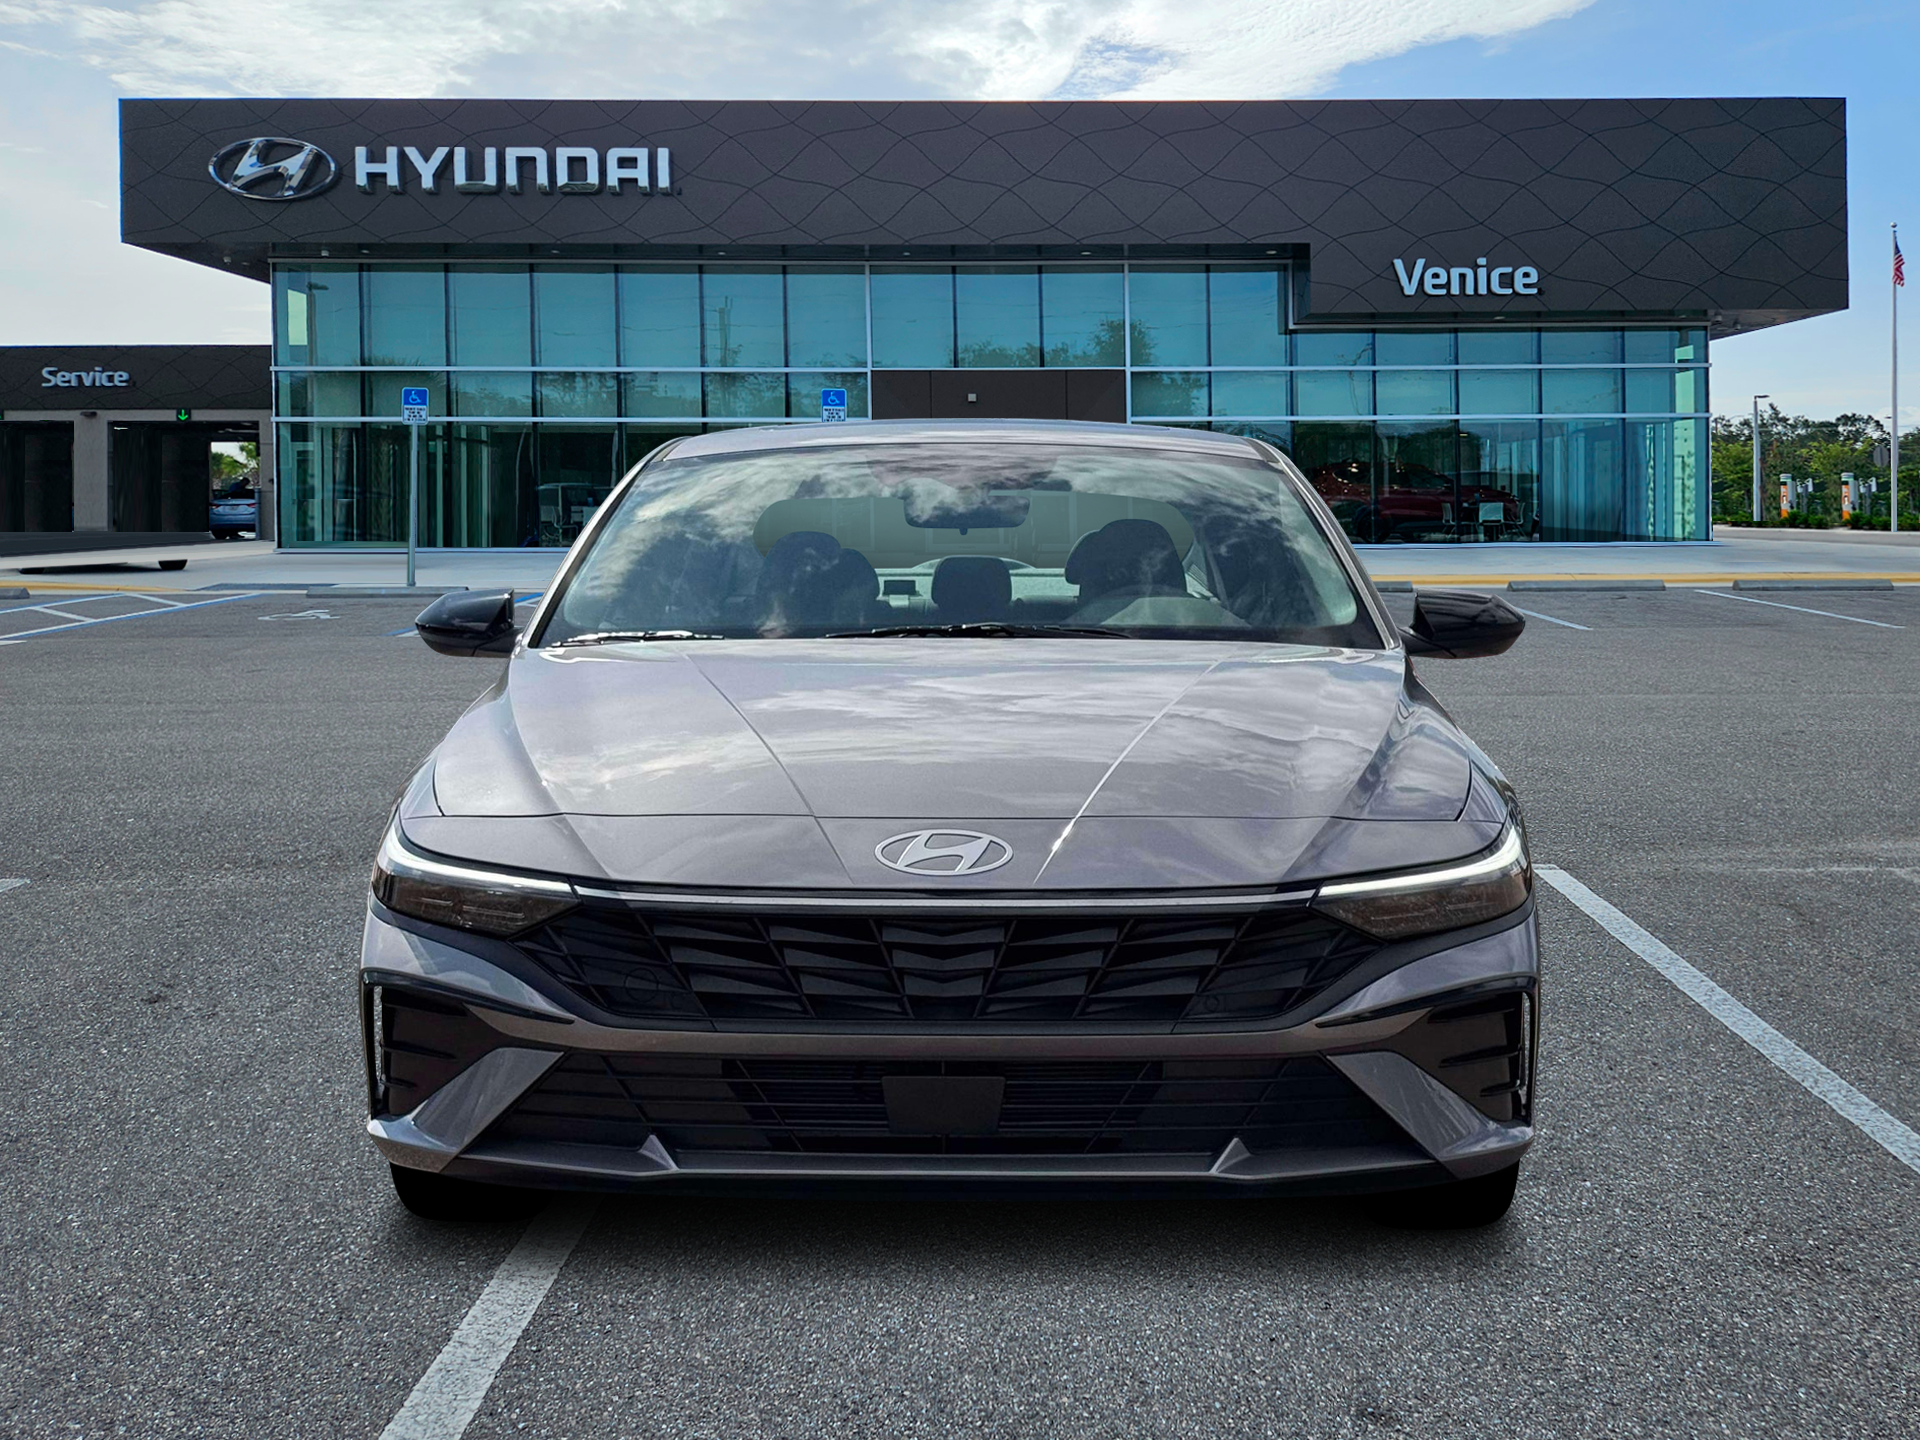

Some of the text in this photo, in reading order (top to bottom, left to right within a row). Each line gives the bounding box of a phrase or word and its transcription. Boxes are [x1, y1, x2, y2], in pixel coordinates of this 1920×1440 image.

[355, 146, 671, 195] HYUNDAI
[1393, 257, 1539, 295] Venice
[41, 366, 130, 388] Service
